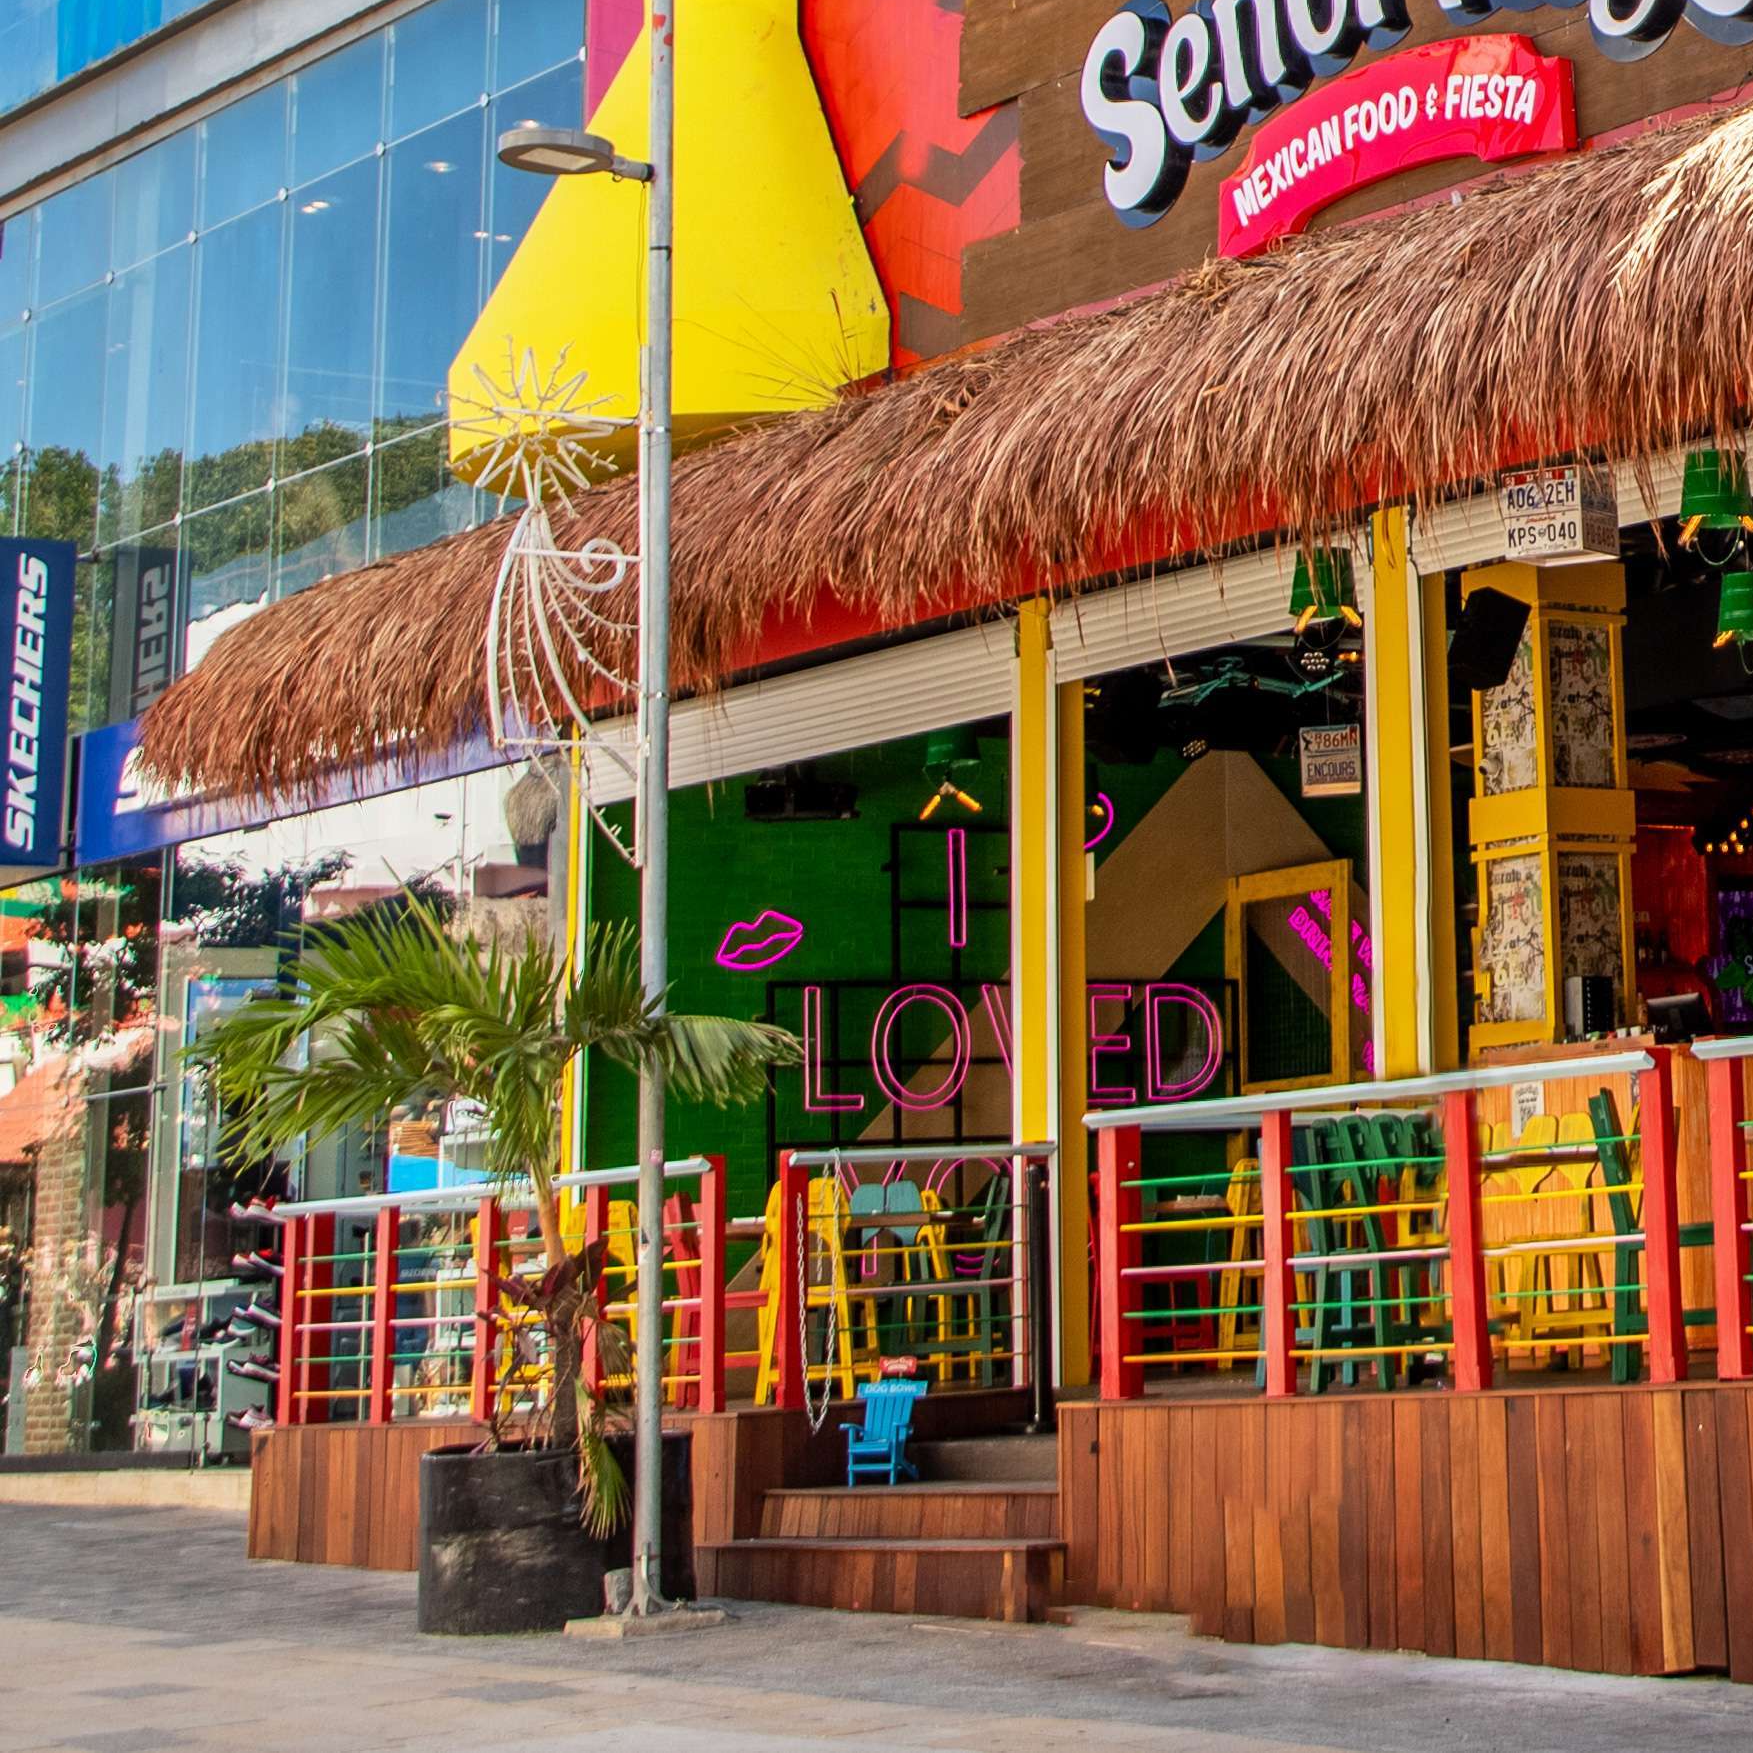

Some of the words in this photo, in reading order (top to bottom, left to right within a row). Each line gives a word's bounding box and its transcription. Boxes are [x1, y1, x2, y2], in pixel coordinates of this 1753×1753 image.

[1232, 113, 1342, 227] MEXICAN
[1344, 85, 1418, 151] FOOD
[1444, 74, 1538, 125] FIESTA
[4, 551, 49, 853] SKECHERS
[947, 828, 967, 948] I
